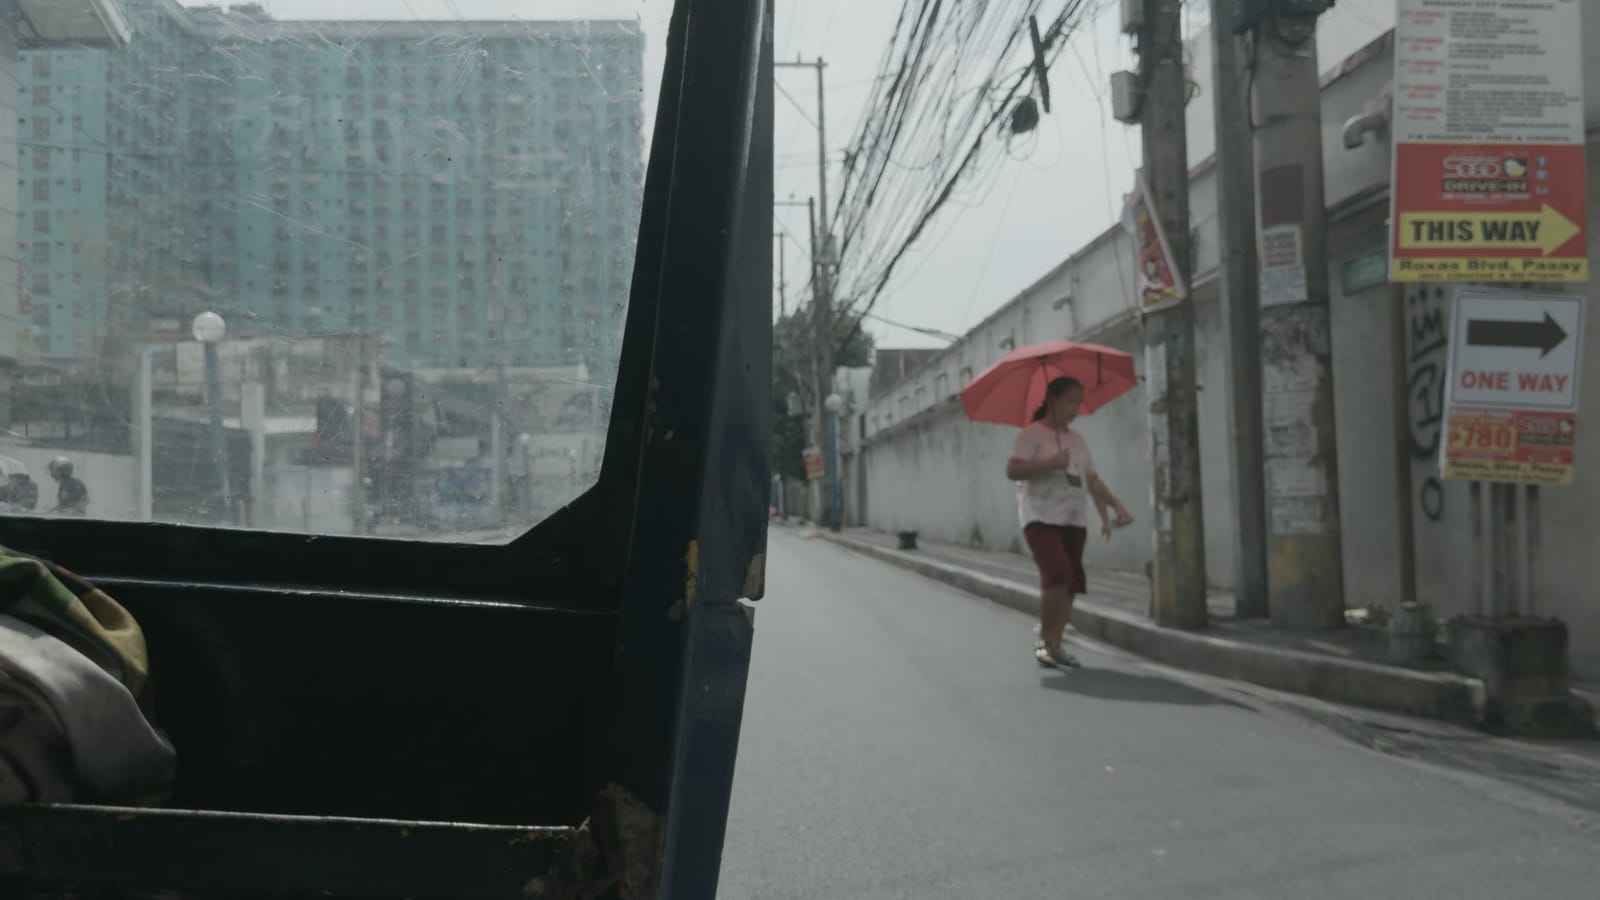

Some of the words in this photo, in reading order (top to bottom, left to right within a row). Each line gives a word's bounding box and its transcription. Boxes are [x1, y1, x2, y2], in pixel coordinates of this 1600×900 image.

[1443, 180, 1527, 192] DRIVE-IN
[1410, 220, 1473, 241] THIS
[1480, 220, 1540, 241] WAY
[1400, 260, 1459, 270] Roxas
[1522, 261, 1582, 272] Pasay
[1460, 370, 1510, 390] ONE
[1518, 373, 1568, 392] WAY
